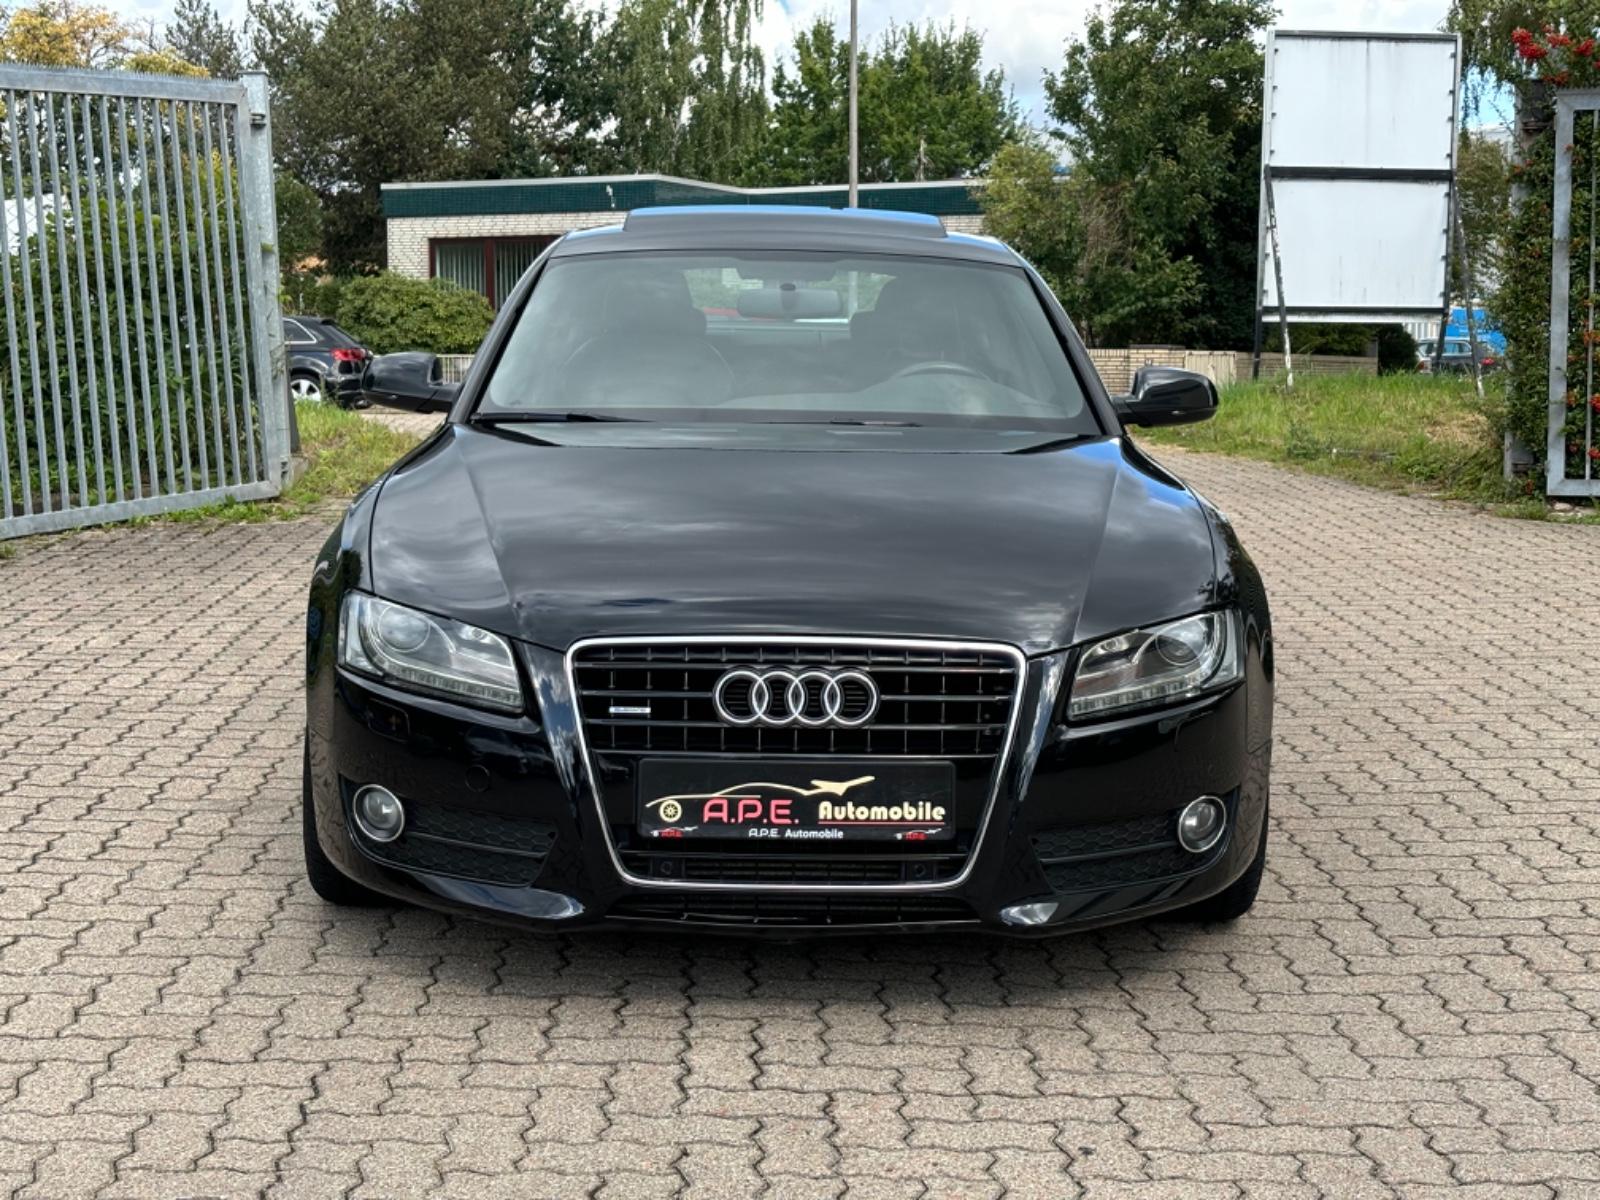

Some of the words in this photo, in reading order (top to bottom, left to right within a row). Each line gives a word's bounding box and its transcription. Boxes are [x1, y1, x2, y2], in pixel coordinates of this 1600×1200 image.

[703, 798, 799, 824] A.P.E.
[818, 801, 946, 820] Automobile
[785, 828, 844, 839] Automobile
